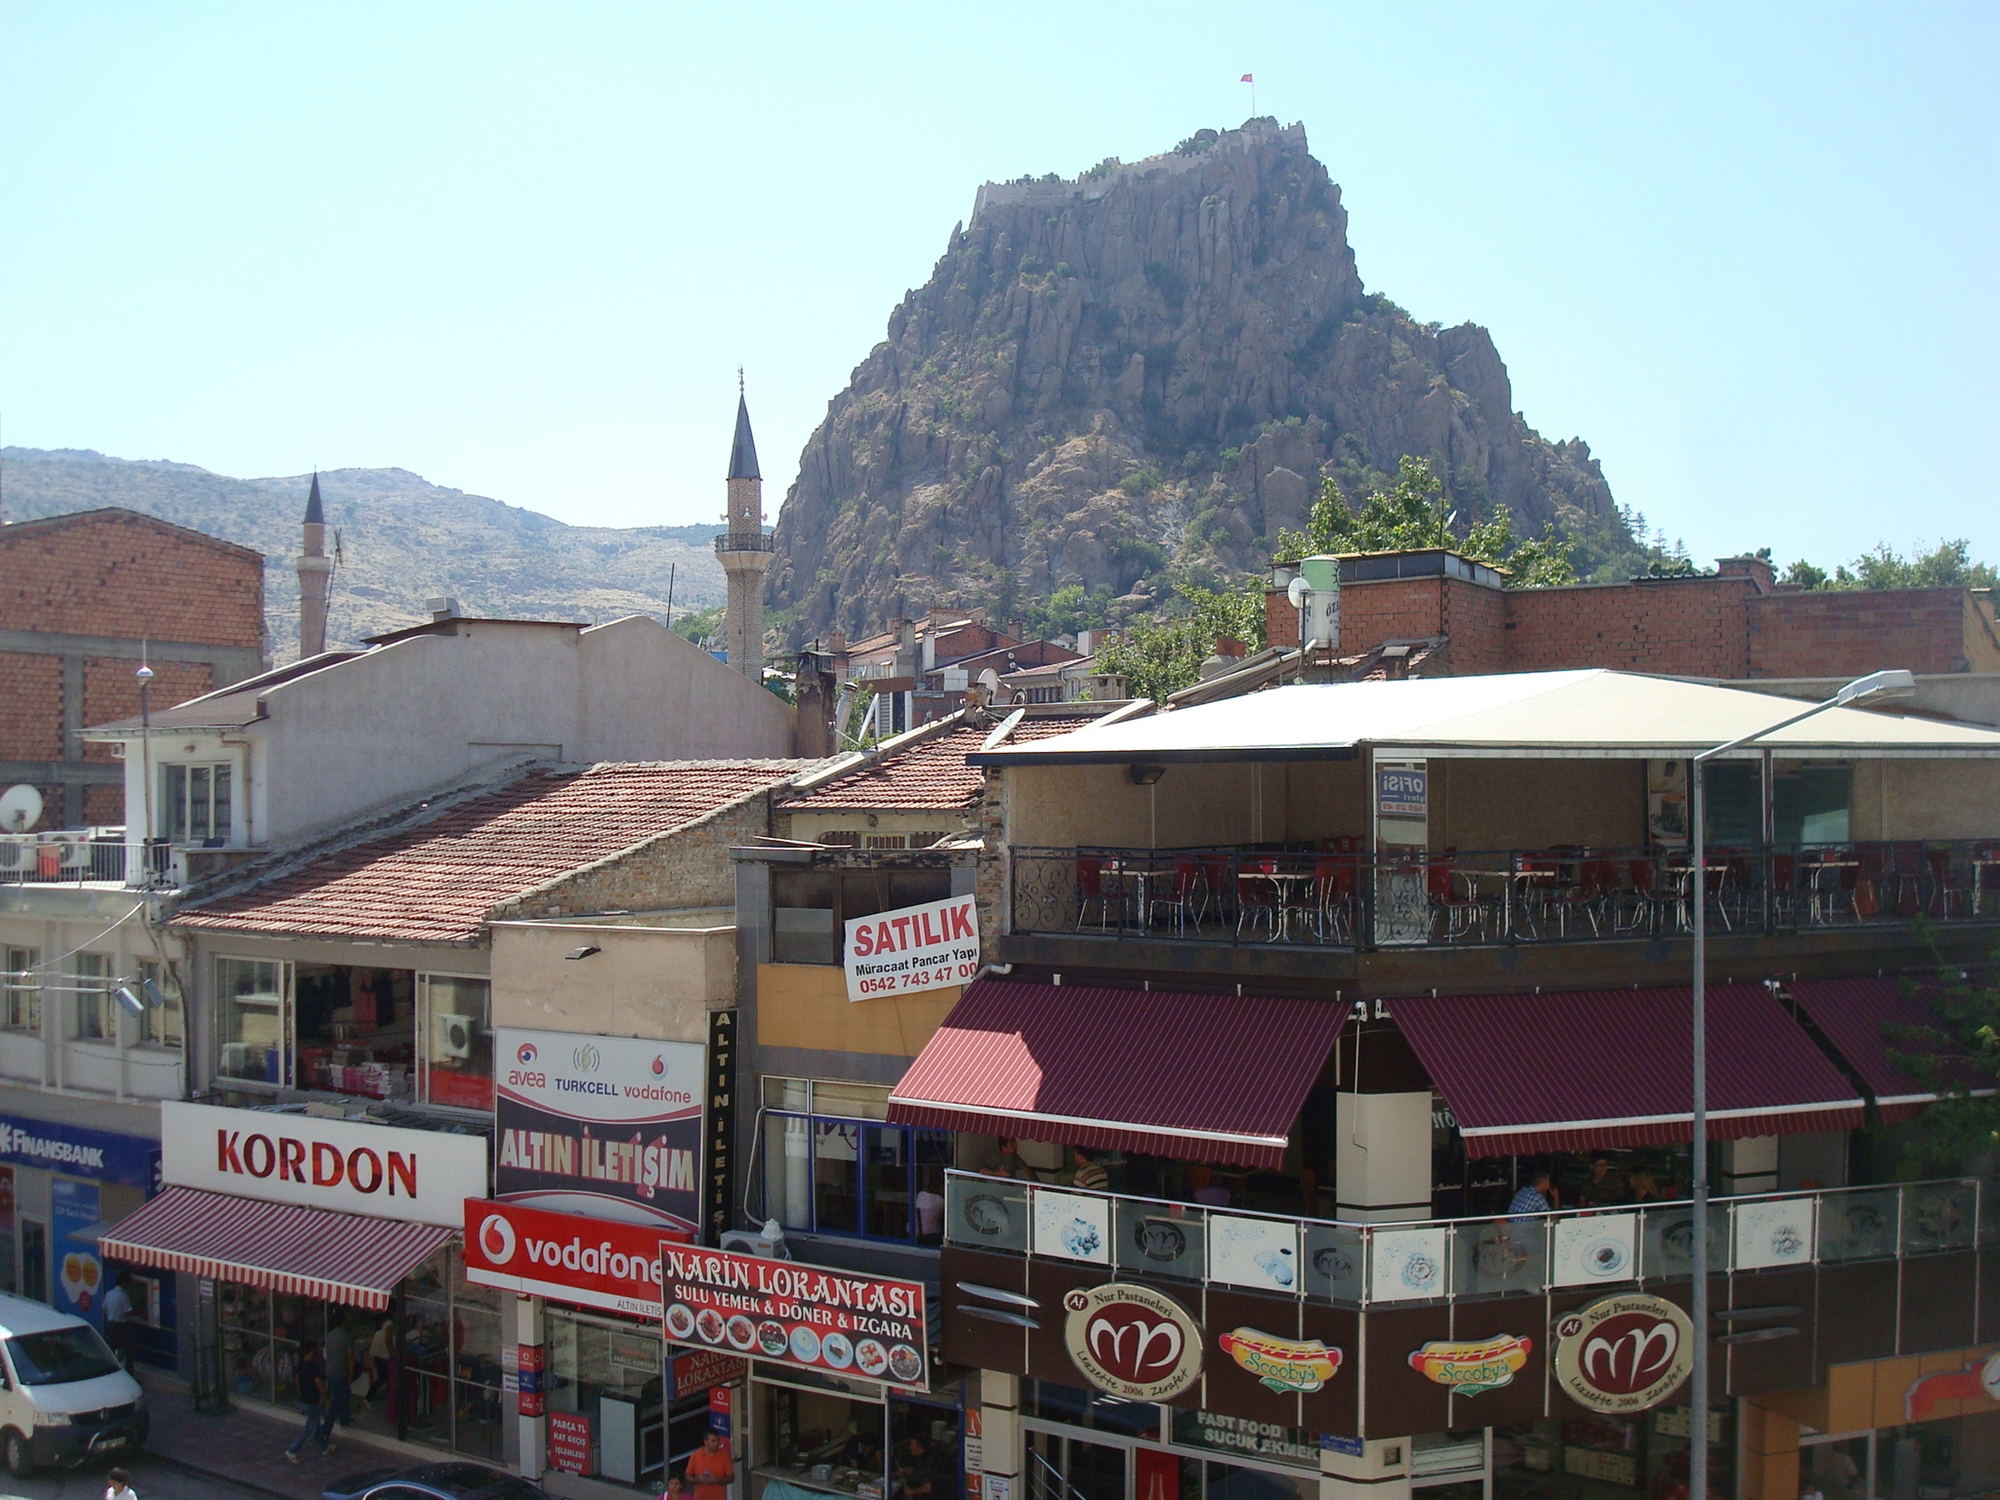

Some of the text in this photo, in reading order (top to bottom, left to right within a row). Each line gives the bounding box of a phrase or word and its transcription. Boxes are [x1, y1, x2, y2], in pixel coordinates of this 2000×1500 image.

[854, 903, 975, 957] SATILIK
[855, 948, 977, 977] Müracaat Pancar Yapı
[860, 976, 896, 993] 0542
[901, 971, 930, 988] 743
[934, 966, 953, 982] 47
[713, 1012, 731, 1108] ALTIN
[508, 1069, 546, 1089] avea
[554, 1078, 619, 1096] TURKCELL
[623, 1084, 691, 1103] vodafone
[217, 1129, 417, 1199] KORDON
[500, 1125, 695, 1198] ALTIN İLETİŞİM
[524, 1237, 662, 1286] vodafone
[667, 1250, 917, 1319] NARİN LOKANTASI
[616, 1299, 662, 1317] ALTIN İLETİŞ
[674, 1284, 913, 1340] SULU YEMEK & DÖNER & IZGARA
[1070, 1289, 1173, 1318] Af Nur Pastaneleri
[1589, 1308, 1611, 1325] Nur
[1613, 1302, 1669, 1318] Pastaneleri
[677, 1357, 747, 1390] LOKANTASI
[1077, 1350, 1118, 1389] Lezzette
[1122, 1384, 1144, 1396] 2006
[1244, 1352, 1318, 1386] Scooby's
[1438, 1359, 1509, 1384] Scooby's
[552, 1418, 586, 1433] PARÇA TL
[1197, 1411, 1282, 1438] FAST FOOD
[1204, 1428, 1258, 1449] SUCUK
